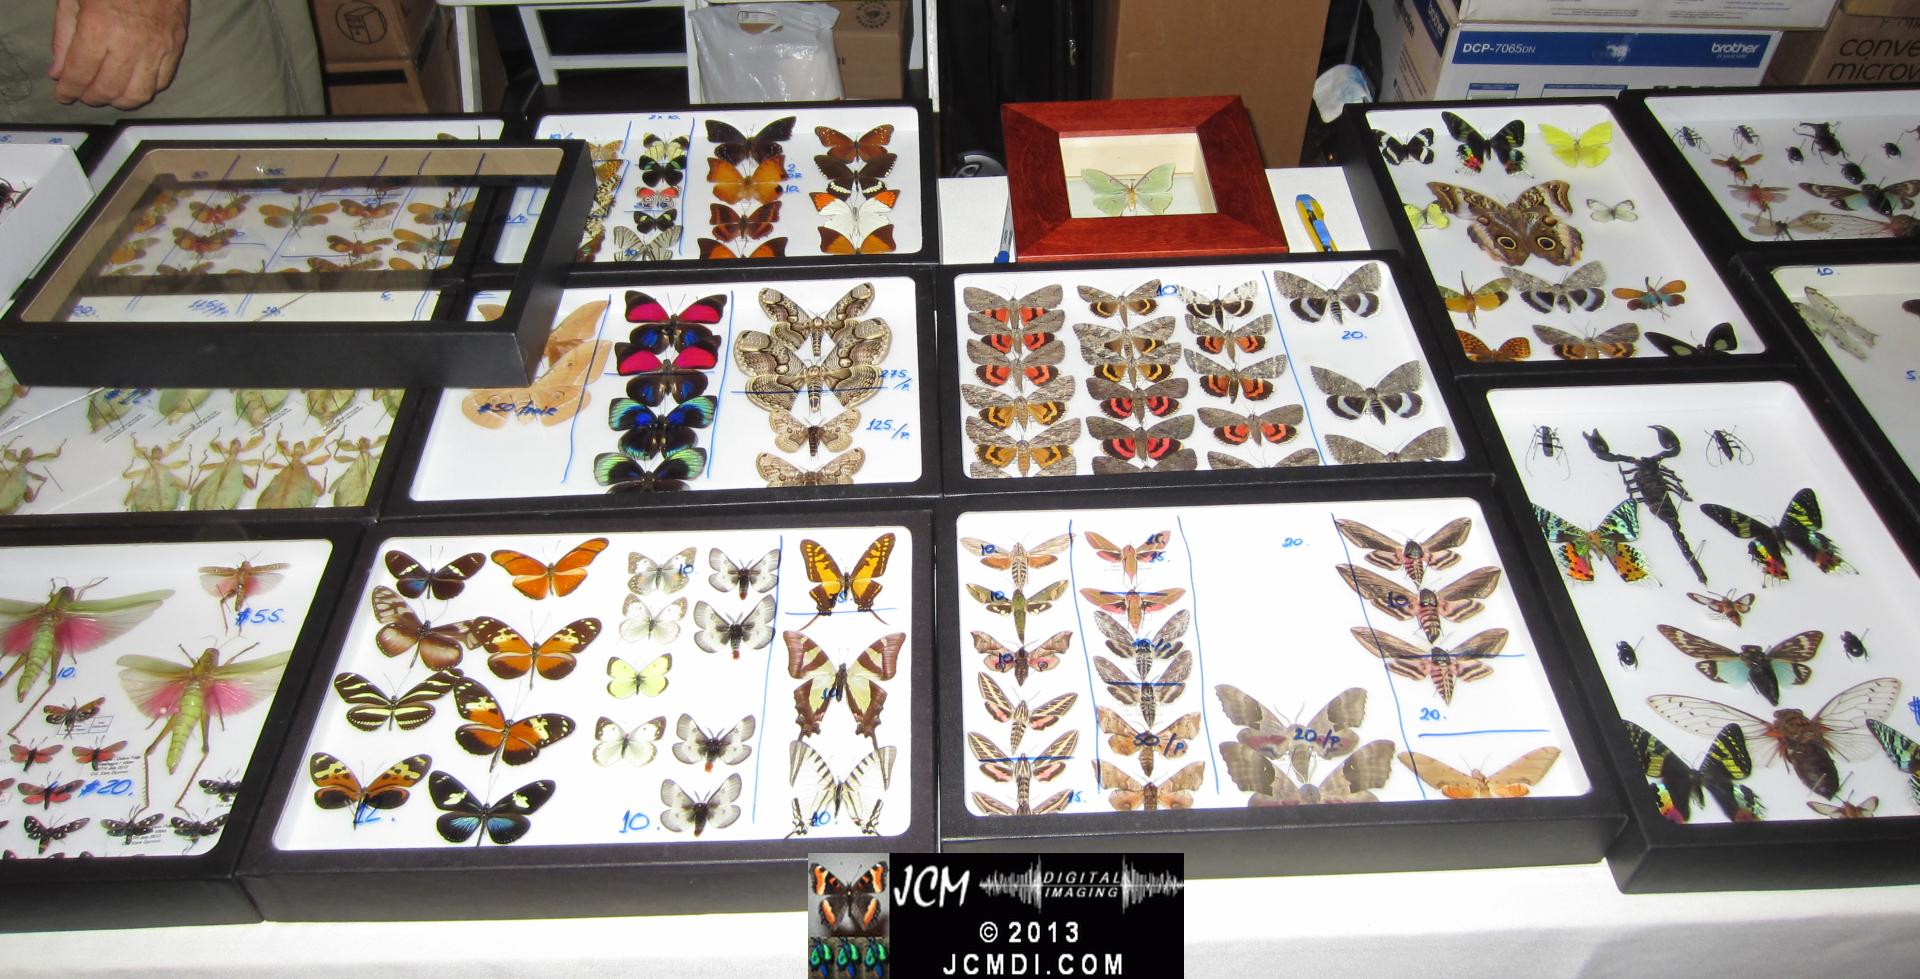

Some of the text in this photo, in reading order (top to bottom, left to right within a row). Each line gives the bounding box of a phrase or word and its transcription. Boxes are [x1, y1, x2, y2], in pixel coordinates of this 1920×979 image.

[1462, 43, 1536, 54] DCP-7065DN
[1711, 42, 1759, 53] brother
[1341, 330, 1368, 340] 20.
[1282, 537, 1310, 548] 20.
[235, 607, 285, 625] $55.
[1419, 707, 1447, 721] 20.
[78, 779, 133, 798] $20.
[619, 809, 660, 833] 10.
